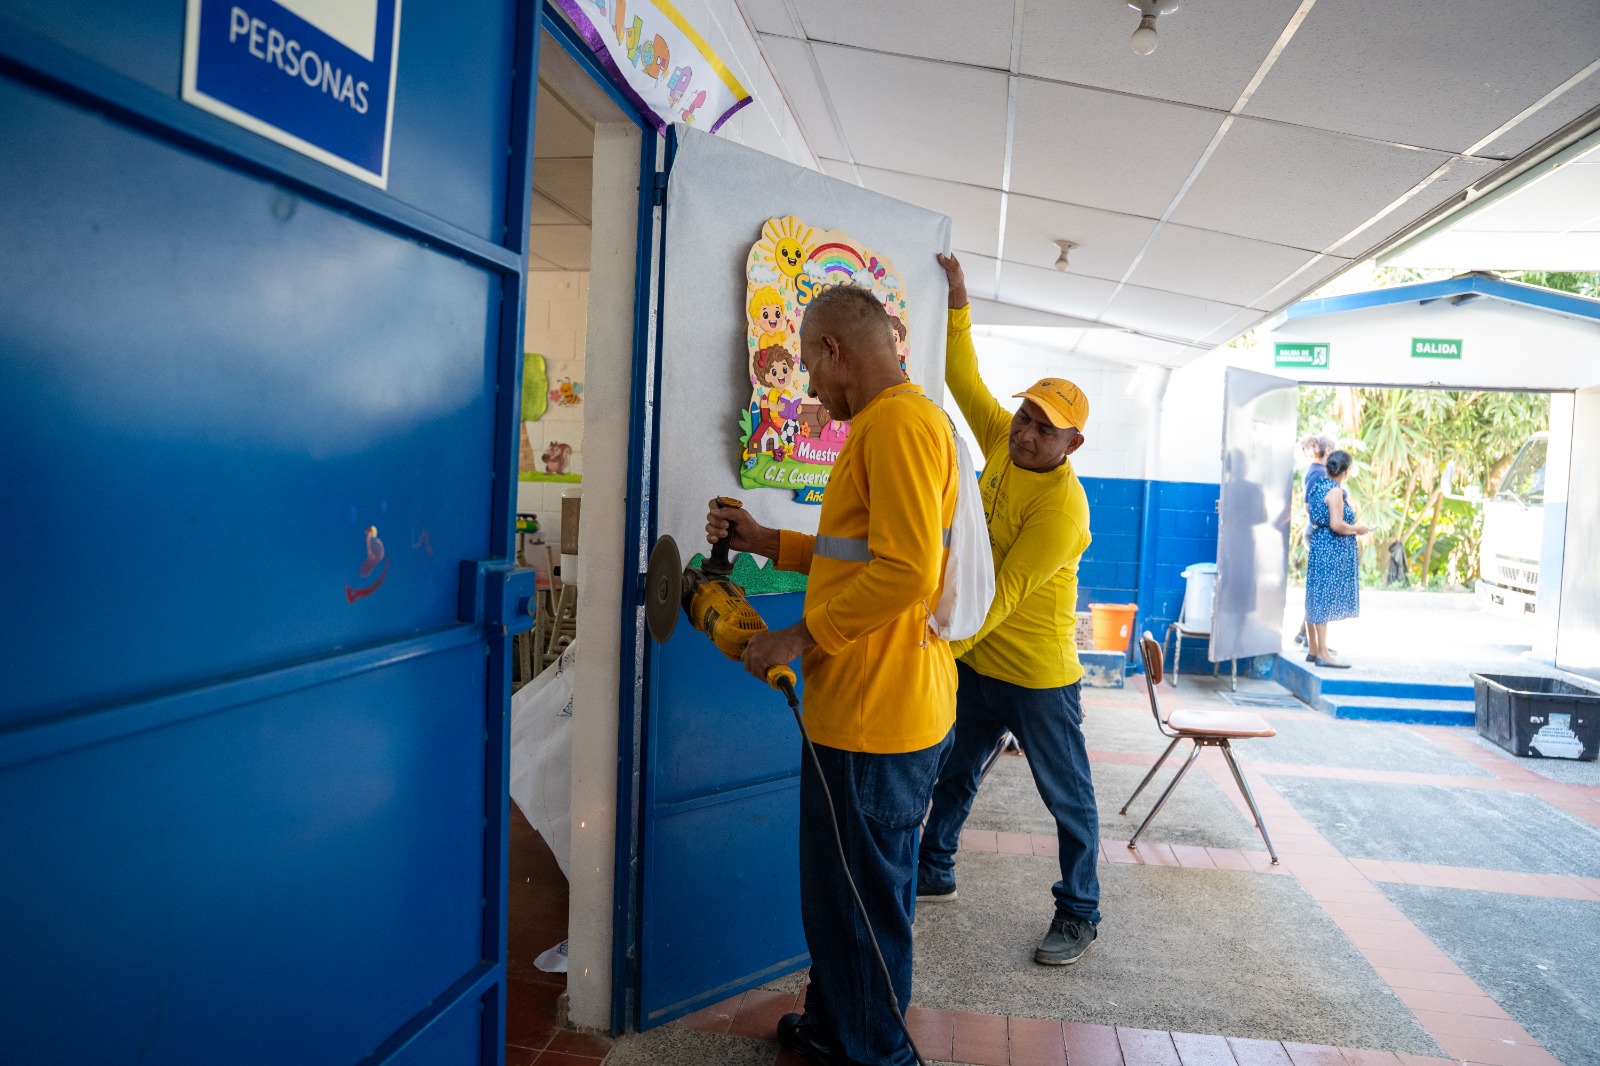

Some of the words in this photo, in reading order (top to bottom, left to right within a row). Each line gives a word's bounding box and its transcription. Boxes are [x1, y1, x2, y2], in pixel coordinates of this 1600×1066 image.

[229, 6, 369, 114] PERSONAS
[1416, 342, 1458, 355] SALIDA
[764, 465, 785, 483] C.E.
